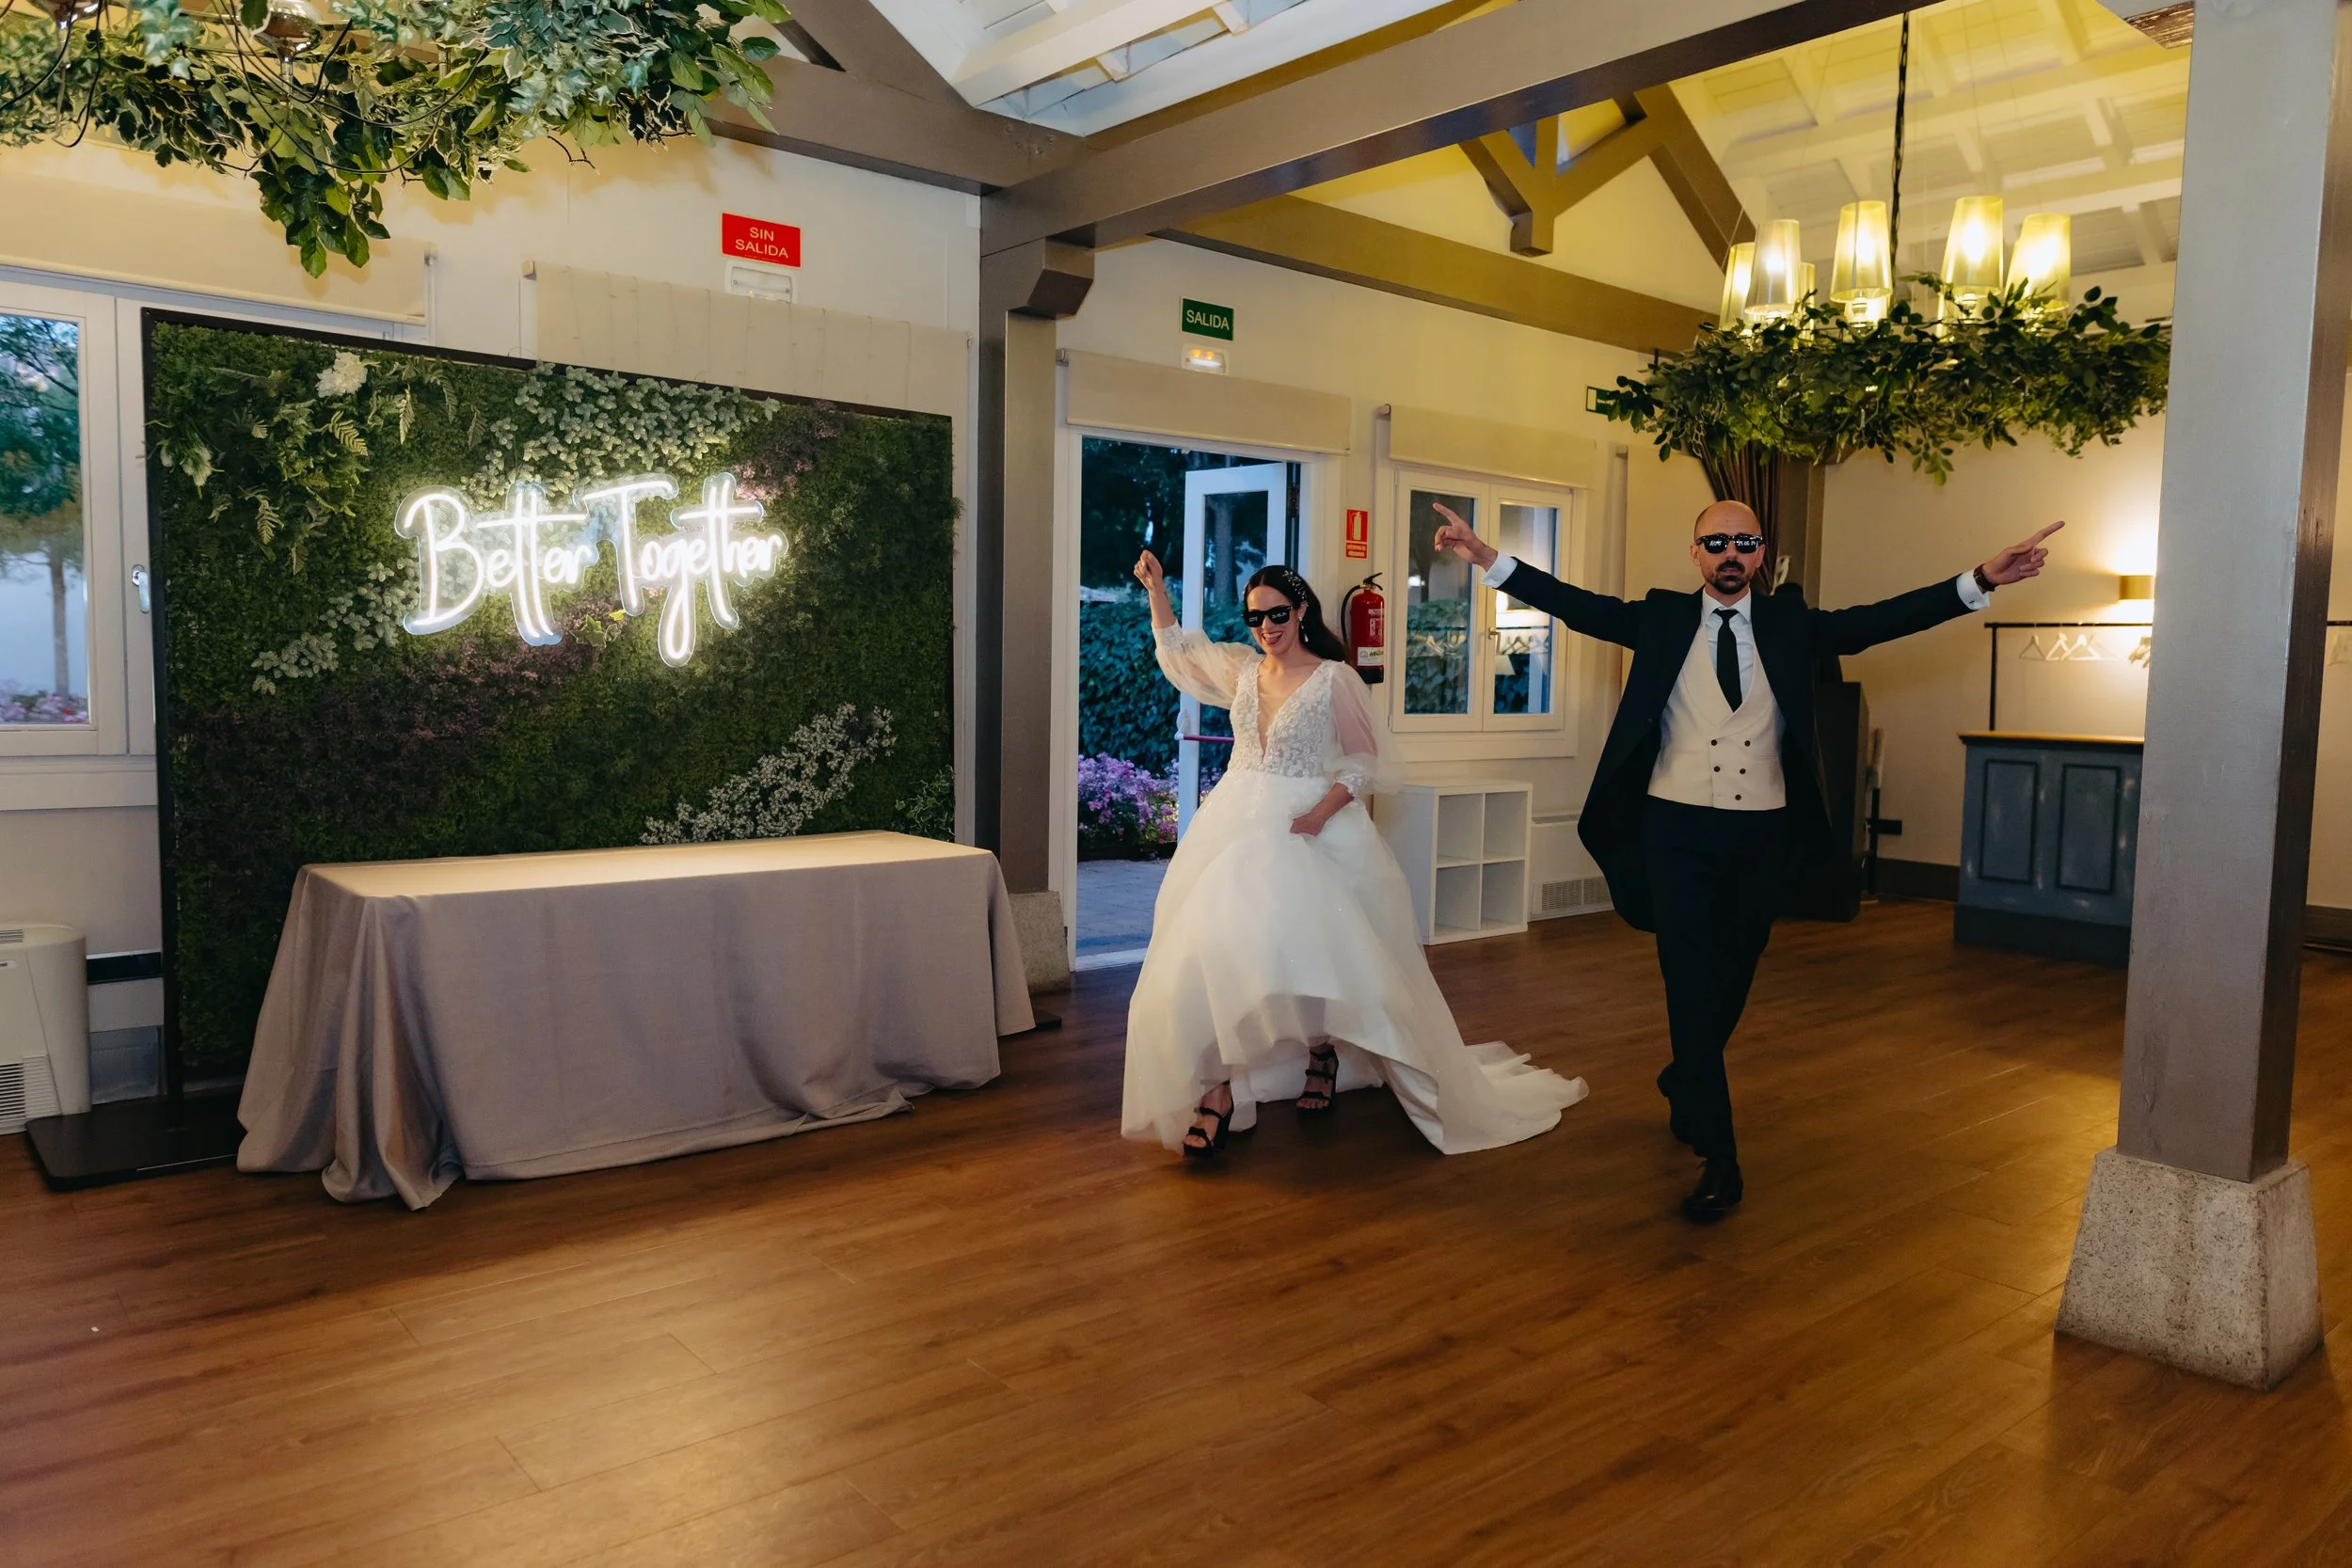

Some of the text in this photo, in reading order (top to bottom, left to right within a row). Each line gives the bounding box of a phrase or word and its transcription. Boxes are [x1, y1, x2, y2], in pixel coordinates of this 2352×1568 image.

[749, 227, 774, 242] SIN
[735, 239, 789, 259] SALIDA
[1185, 309, 1231, 331] SALIDA
[403, 478, 783, 660] Better Together
